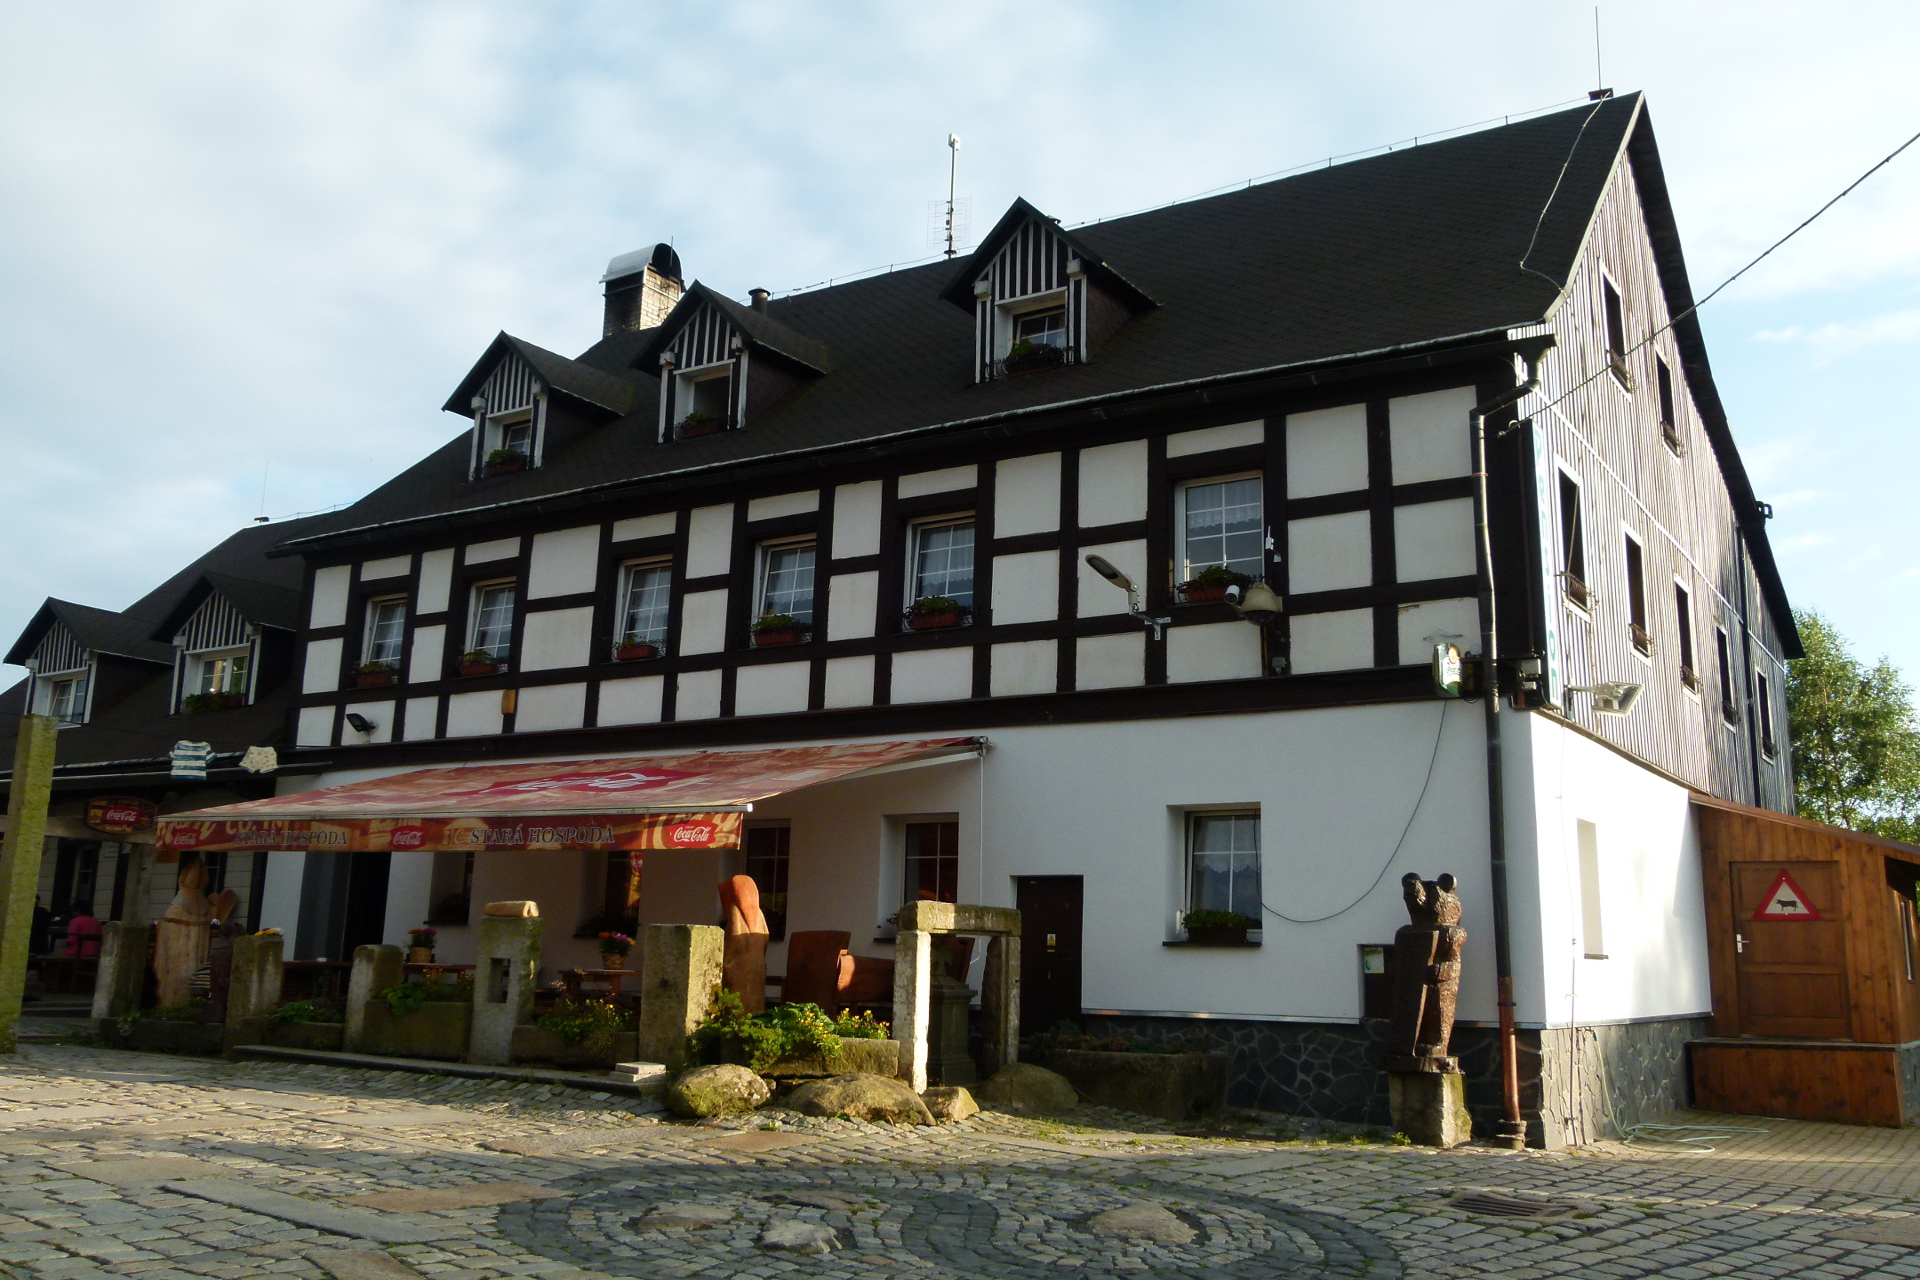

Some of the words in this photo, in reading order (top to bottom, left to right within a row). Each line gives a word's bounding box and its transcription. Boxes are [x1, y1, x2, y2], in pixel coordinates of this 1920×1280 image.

[1535, 428, 1559, 702] Pension
[106, 809, 138, 822] Coca-Cola
[234, 827, 277, 846] STARÁ
[279, 830, 348, 846] HOSPODA
[470, 824, 525, 845] STARÁ
[527, 826, 616, 845] HOSPODA
[673, 825, 712, 843] Coca-Cola
